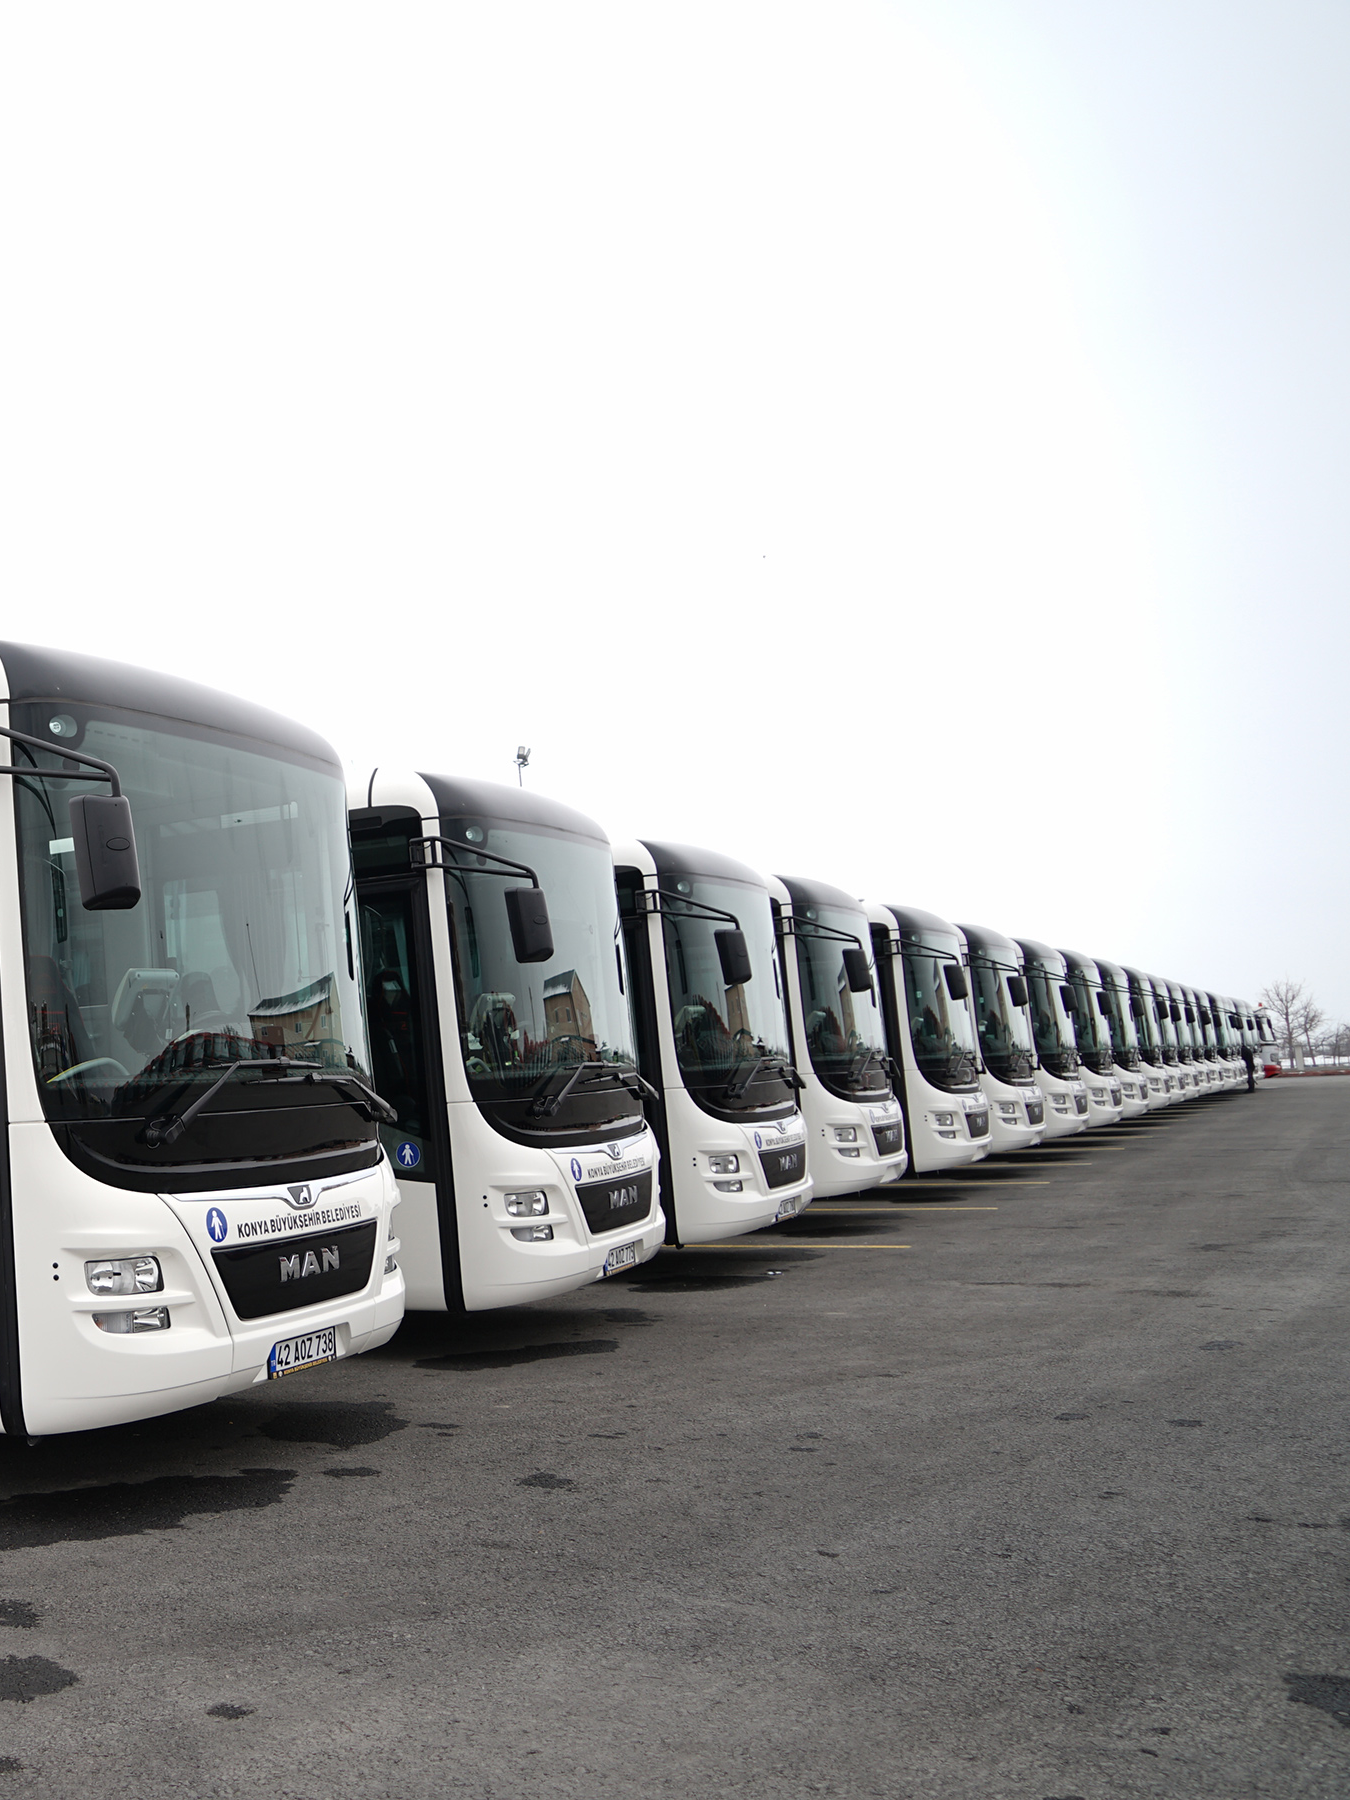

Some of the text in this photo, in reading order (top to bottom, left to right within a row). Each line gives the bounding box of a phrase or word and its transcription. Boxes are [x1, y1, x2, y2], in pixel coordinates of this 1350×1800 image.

[608, 1184, 638, 1209] MAN
[237, 1201, 362, 1238] KONYA BÜYÜKŞEHİR BELEDİYESİ
[279, 1245, 340, 1282] MAN
[277, 1331, 333, 1367] 42 AOZ 738
